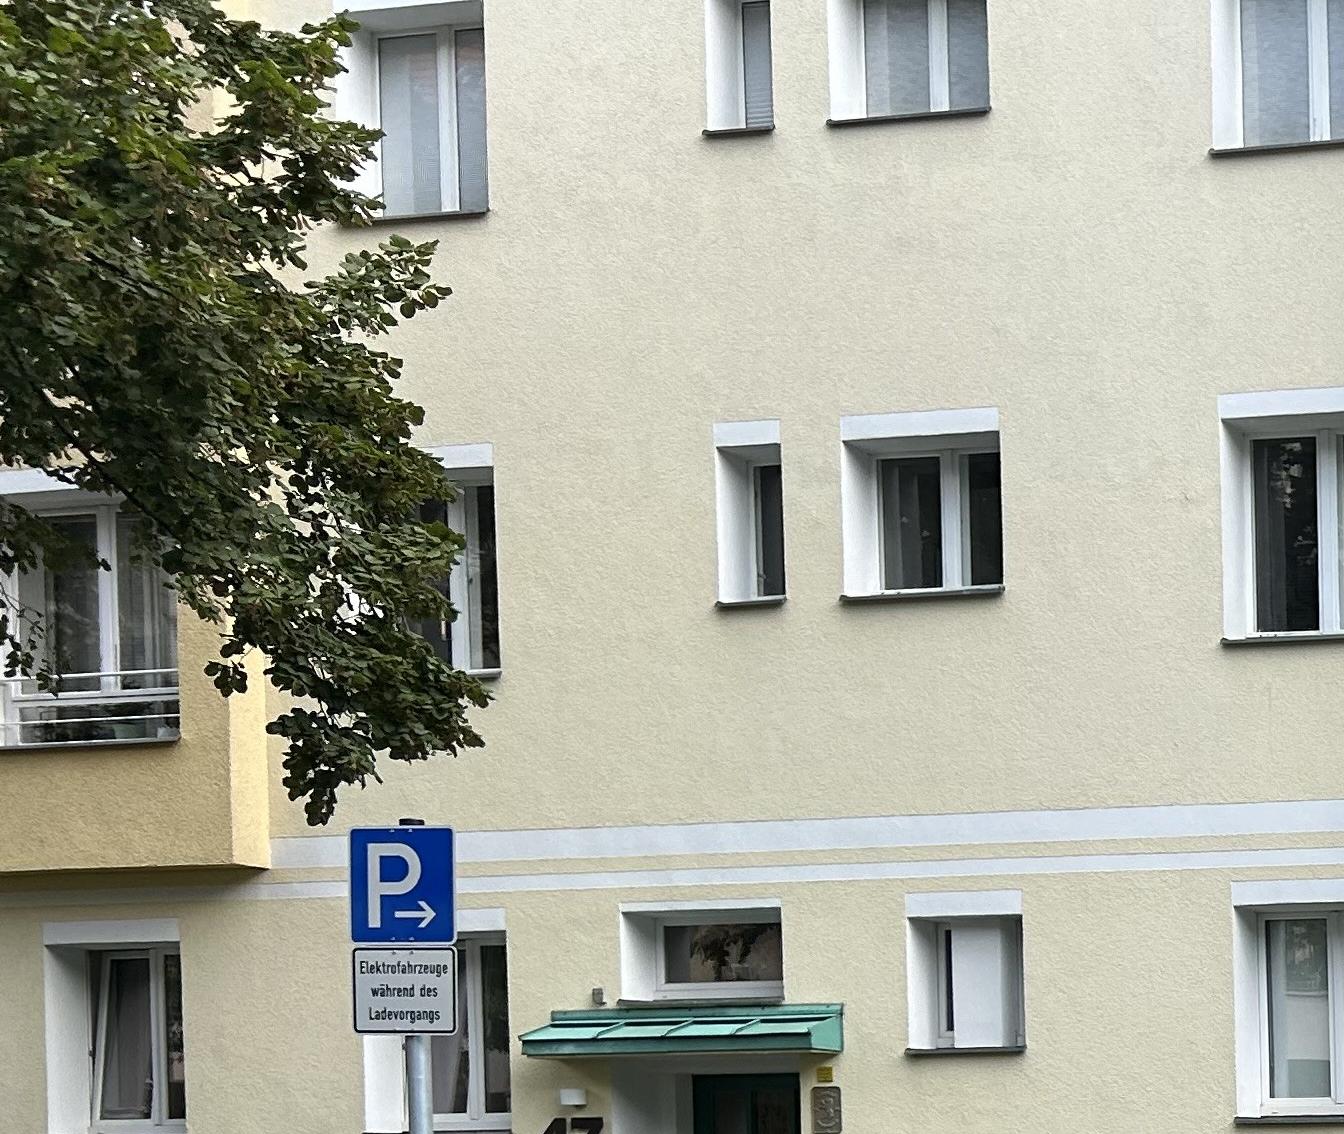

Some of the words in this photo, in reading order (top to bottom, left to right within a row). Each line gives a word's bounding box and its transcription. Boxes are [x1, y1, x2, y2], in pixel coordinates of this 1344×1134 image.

[366, 842, 422, 929] P
[359, 960, 448, 978] Elektrofahrzeuge
[371, 983, 415, 998] während
[420, 984, 438, 998] des
[369, 1006, 441, 1025] Ladevorgangs
